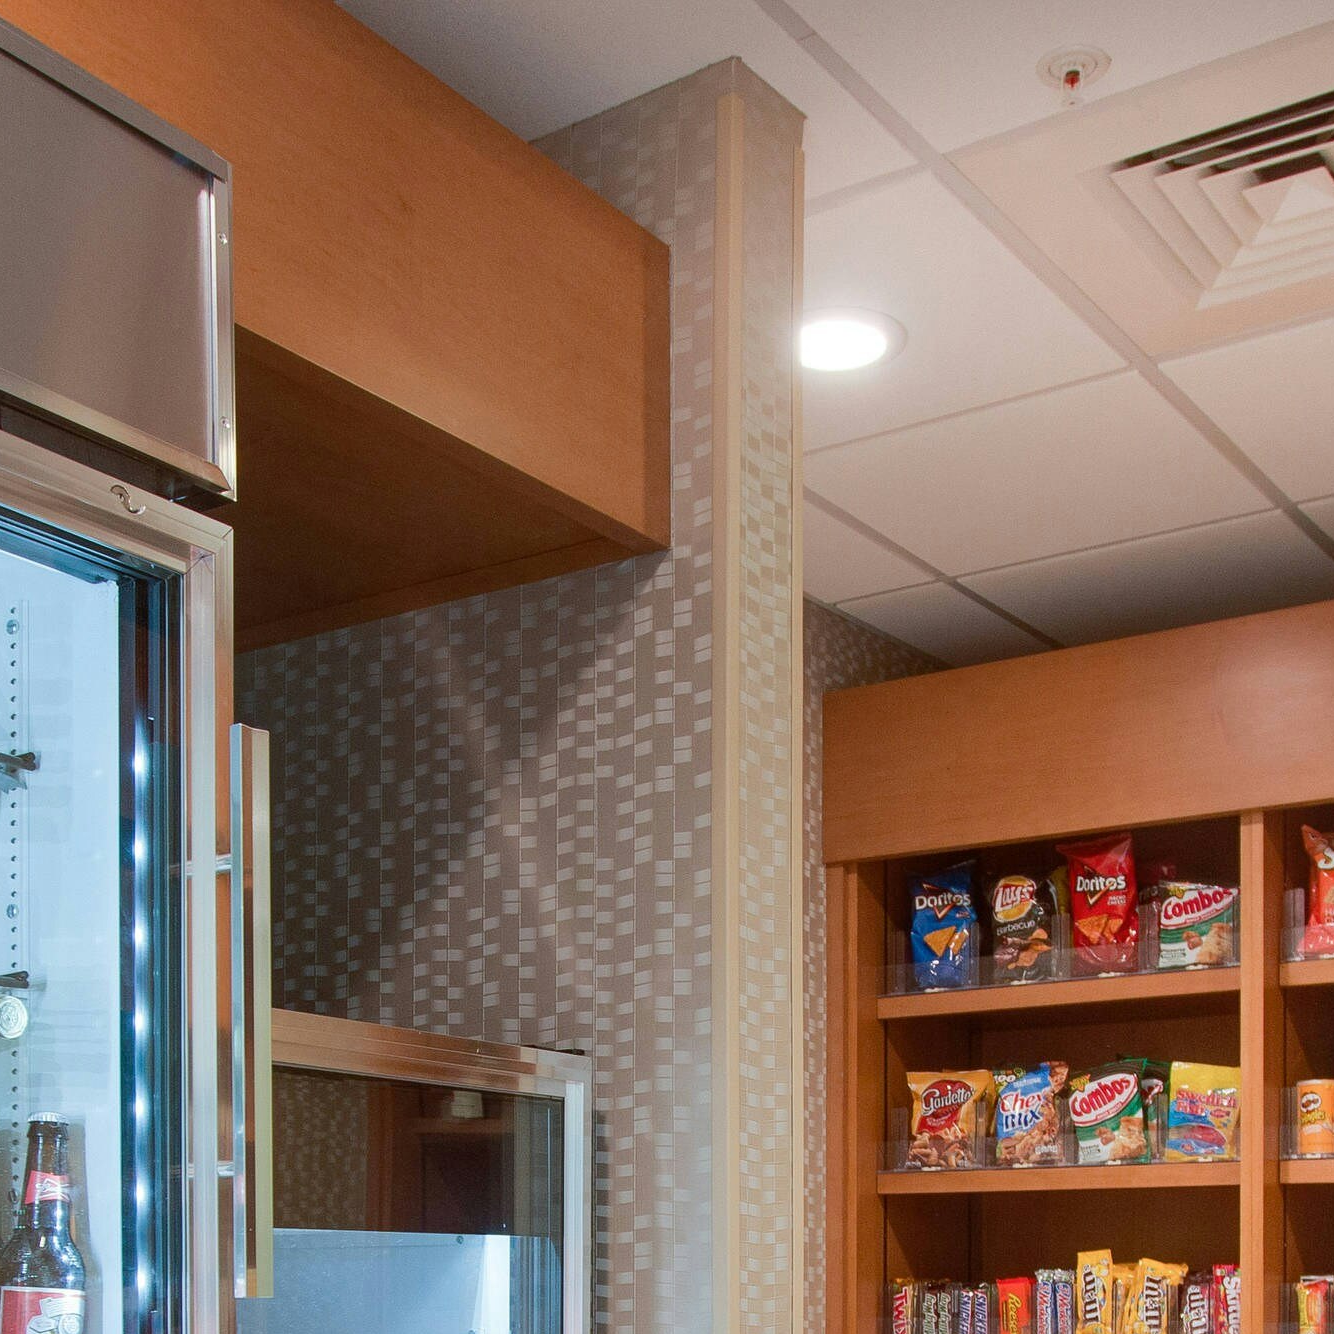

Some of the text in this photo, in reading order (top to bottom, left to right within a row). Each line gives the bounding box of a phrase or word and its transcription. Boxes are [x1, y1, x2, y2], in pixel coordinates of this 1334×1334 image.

[1076, 875, 1126, 892] Doritos
[915, 893, 971, 911] Doritos
[922, 1088, 975, 1117] Gardetto'
[1071, 1075, 1132, 1117] Combos
